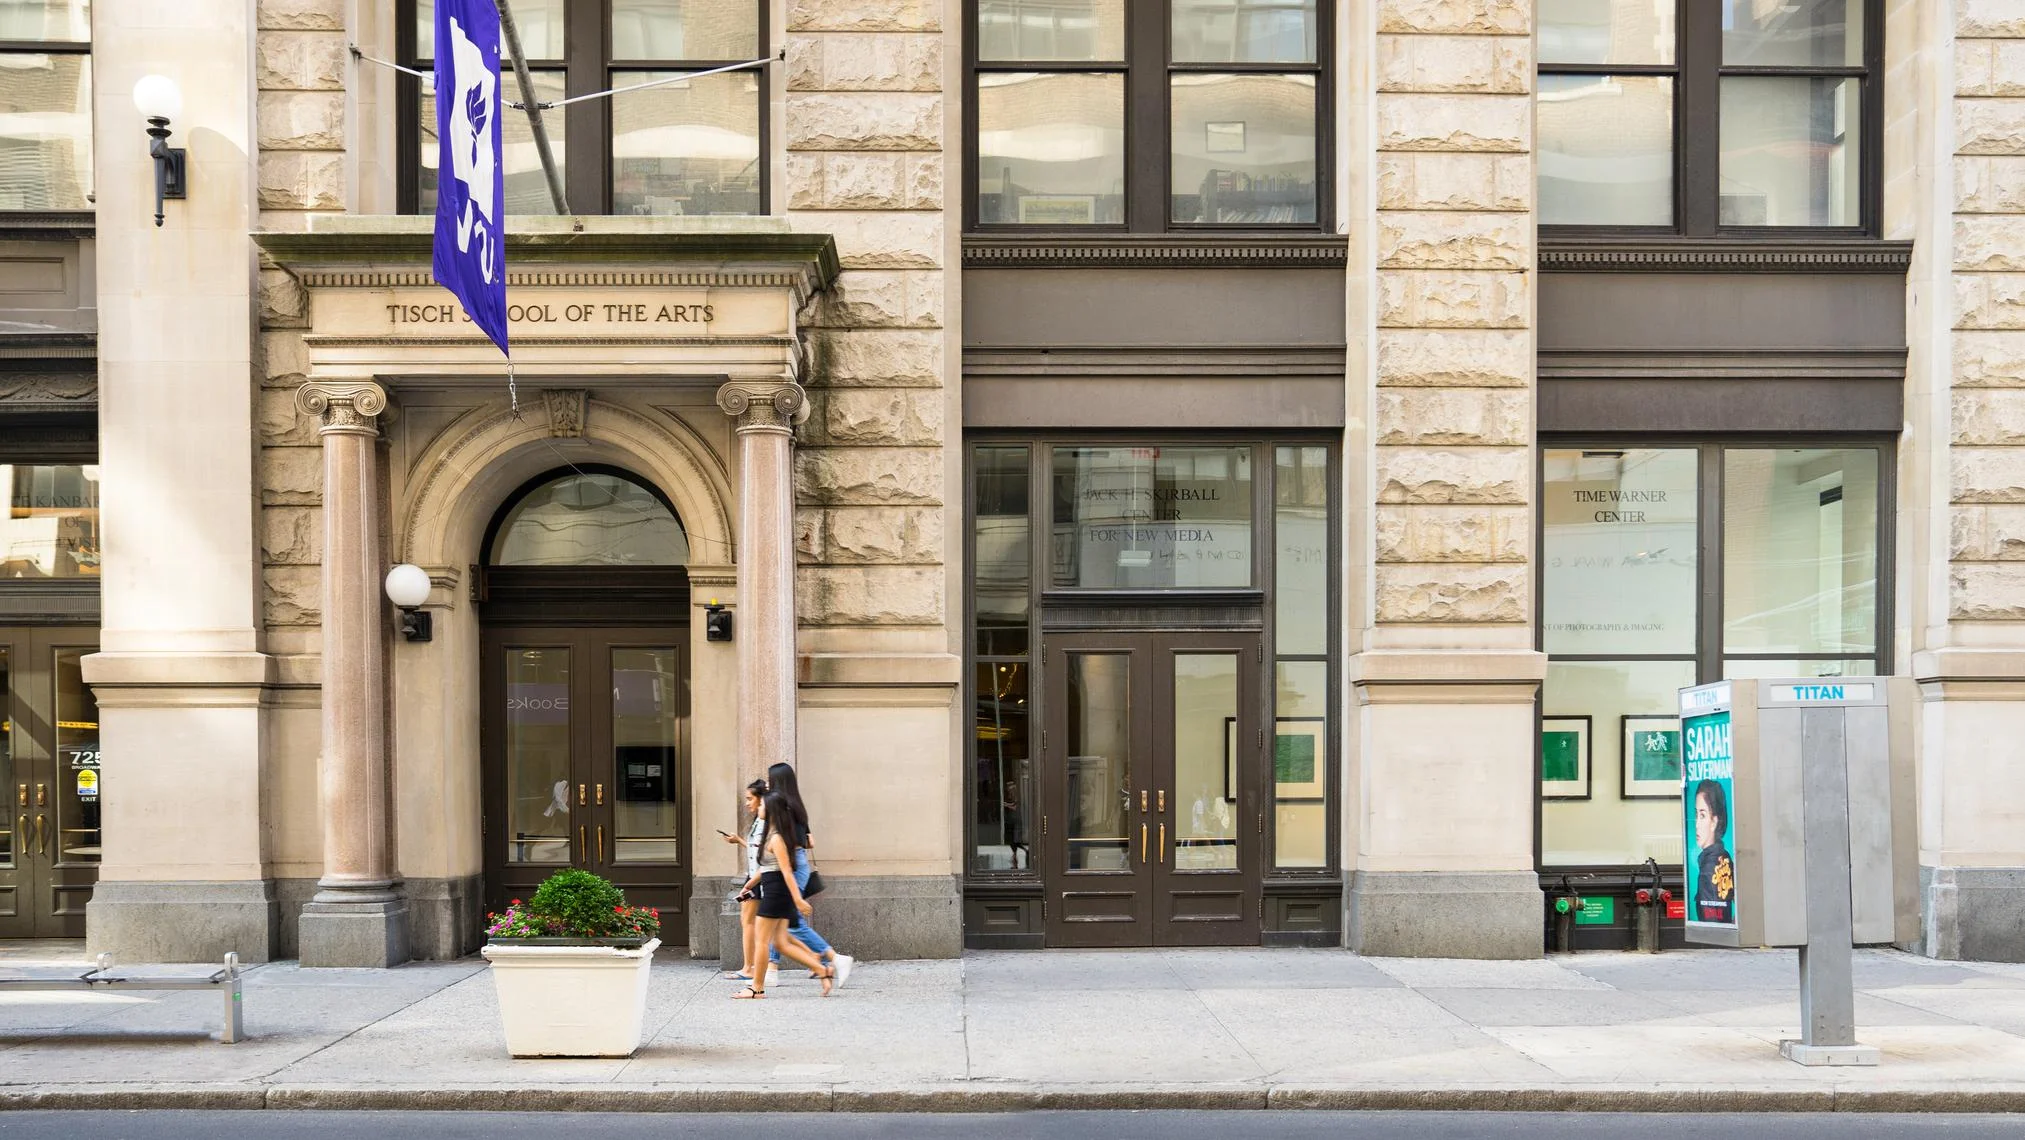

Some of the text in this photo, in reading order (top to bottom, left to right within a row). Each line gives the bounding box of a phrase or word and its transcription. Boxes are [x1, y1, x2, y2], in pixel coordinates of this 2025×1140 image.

[387, 304, 714, 322] TISCH SOOL OF THE ARTS
[1084, 489, 1118, 501] JACK
[1145, 489, 1220, 501] SKIRBALL
[1573, 490, 1667, 502] TIME WARNER
[1122, 509, 1182, 521] CENTER
[1594, 511, 1646, 523] CENTER
[1090, 530, 1214, 541] FOR NEW MEDIA
[1694, 689, 1718, 704] TITAN
[1793, 686, 1845, 700] TITAN
[1687, 722, 1731, 761] SARAH
[1688, 758, 1732, 782] SILVERMAN
